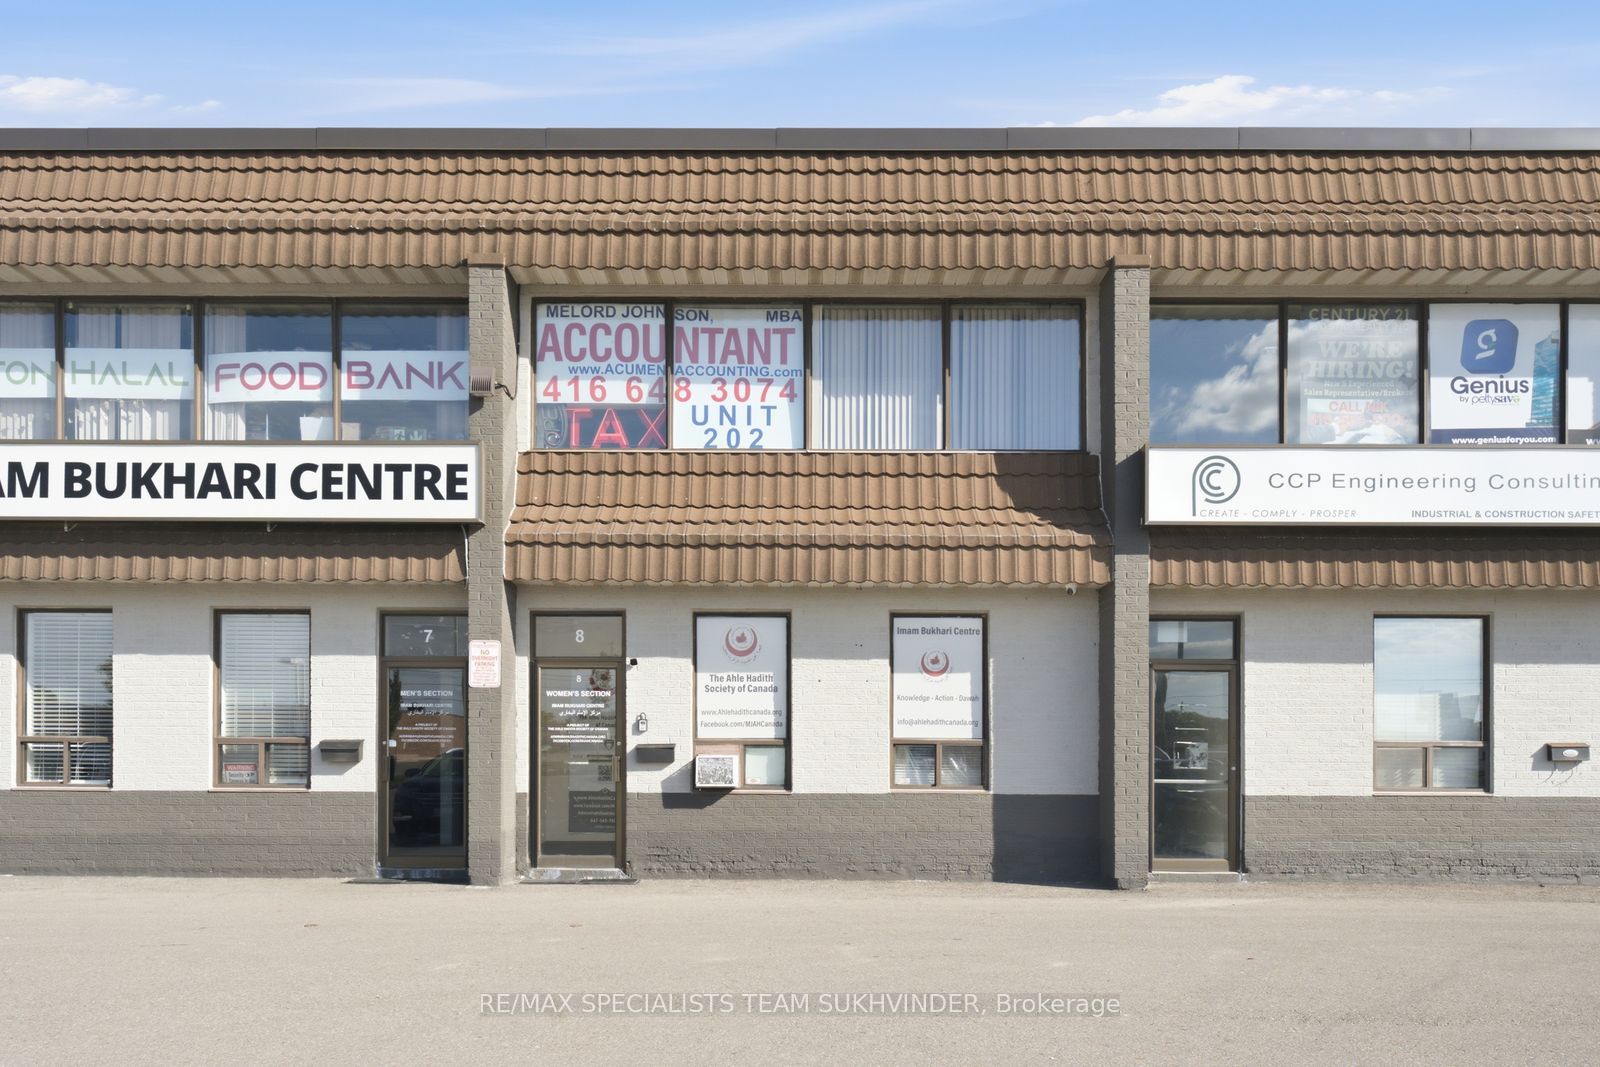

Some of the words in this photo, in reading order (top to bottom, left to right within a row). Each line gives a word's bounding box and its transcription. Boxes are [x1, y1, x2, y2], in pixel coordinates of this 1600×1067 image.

[546, 305, 616, 318] MELORD
[766, 310, 802, 323] MBA
[1309, 308, 1390, 321] CENTURY
[1395, 308, 1409, 321] 21
[1319, 340, 1403, 358] WE'RE
[0, 361, 58, 385] ON
[71, 360, 190, 387] HALAL
[215, 362, 328, 392] FOOD
[346, 360, 466, 390] BANK
[1308, 360, 1414, 378] HIRING!
[543, 375, 607, 402] 416
[711, 377, 798, 403] 3074
[1450, 374, 1529, 394] Genius
[1459, 395, 1469, 403] by
[692, 405, 777, 426] UNIT
[566, 407, 667, 449] TAX
[704, 428, 764, 449] 202
[1451, 435, 1556, 445] www.geniusforyou.com
[64, 461, 277, 499] BUKHARI
[290, 462, 468, 500] CENTRE
[1268, 472, 1321, 489] CCP
[1332, 472, 1476, 493] Engineering
[1200, 509, 1240, 518] CREATE
[1252, 509, 1298, 518] COMPLY
[1309, 509, 1357, 518] PROSPER
[1411, 509, 1472, 518] INDUSTRIAL
[1474, 510, 1482, 518] &
[1484, 510, 1565, 518] CONSTRUCTION
[424, 629, 433, 643] 7
[576, 629, 584, 643] 8
[896, 626, 919, 635] Imam
[921, 626, 952, 635] Bukhari
[953, 627, 981, 636] Centre
[576, 674, 582, 682] 8
[709, 674, 724, 682] The
[726, 674, 744, 682] Ahle
[746, 674, 774, 682] Hadith
[704, 684, 736, 694] Society
[737, 684, 746, 692] of
[747, 684, 778, 692] Canada
[896, 694, 930, 702] Knowledge
[701, 708, 782, 717] www.Ahlehadithcanada.org
[896, 718, 979, 727] info@ahlehadithcanada.org
